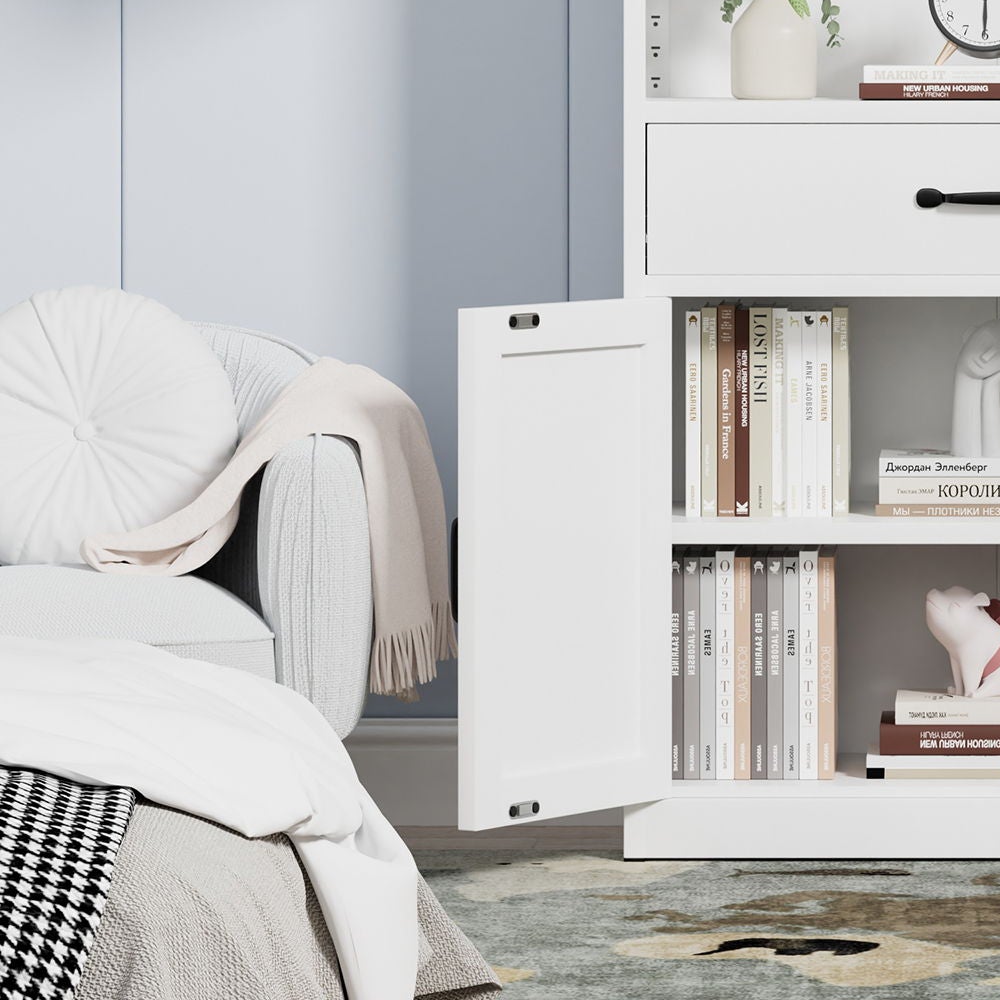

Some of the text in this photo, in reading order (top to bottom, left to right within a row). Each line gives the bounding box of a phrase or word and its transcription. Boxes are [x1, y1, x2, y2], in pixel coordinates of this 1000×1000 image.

[947, 10, 954, 22] 8
[963, 24, 969, 35] 7
[981, 28, 989, 40] 6
[753, 314, 768, 402] LOST FISH
[775, 318, 784, 386] MAKING IT
[721, 369, 731, 460] Gardens in France
[886, 462, 988, 474] Джордан Элленберг
[938, 484, 1000, 498] КОРОЛИ
[893, 507, 910, 516] МЫ
[927, 507, 980, 516] ПЛОТНИКИ
